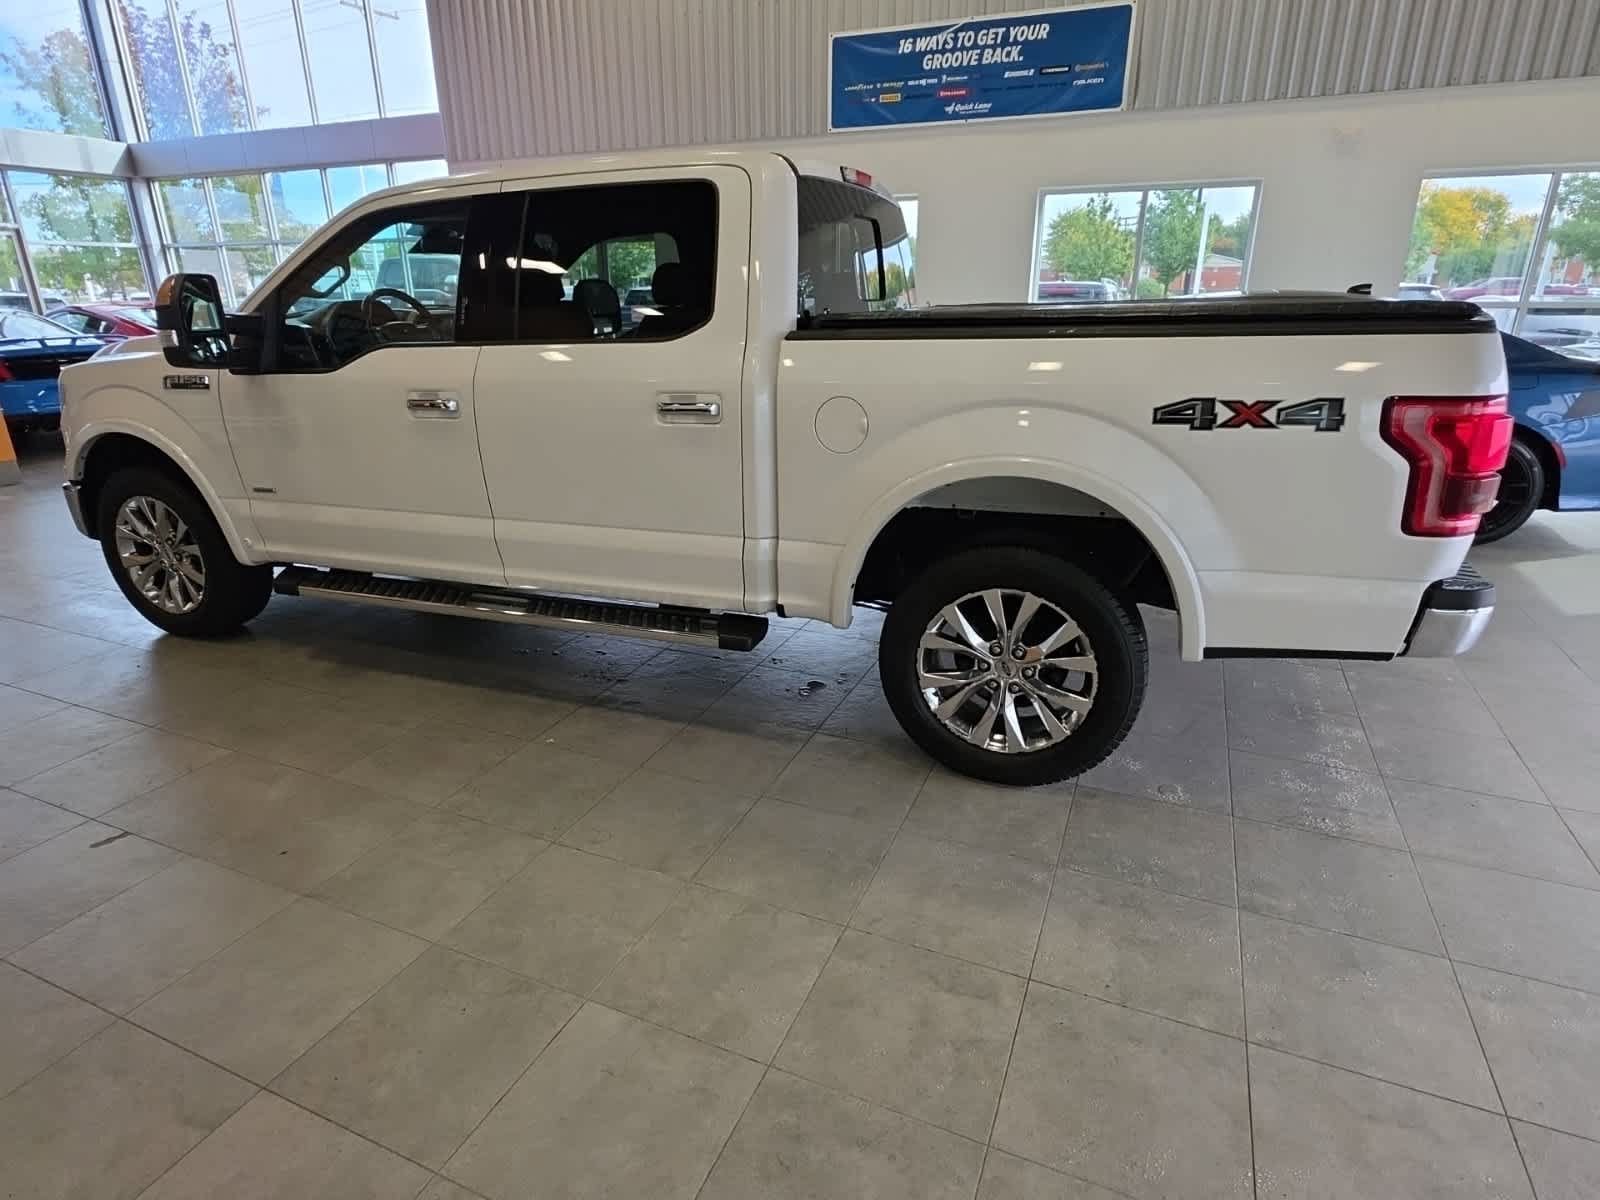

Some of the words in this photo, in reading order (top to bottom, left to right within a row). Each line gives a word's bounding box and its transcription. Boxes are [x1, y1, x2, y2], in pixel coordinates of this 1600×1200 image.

[898, 38, 913, 54] 16
[915, 32, 954, 52] WAYS
[957, 30, 974, 48] TO
[977, 28, 1006, 46] GET
[1009, 23, 1050, 42] YOUR
[922, 50, 981, 70] GROOVE
[982, 45, 1024, 64] BACK.
